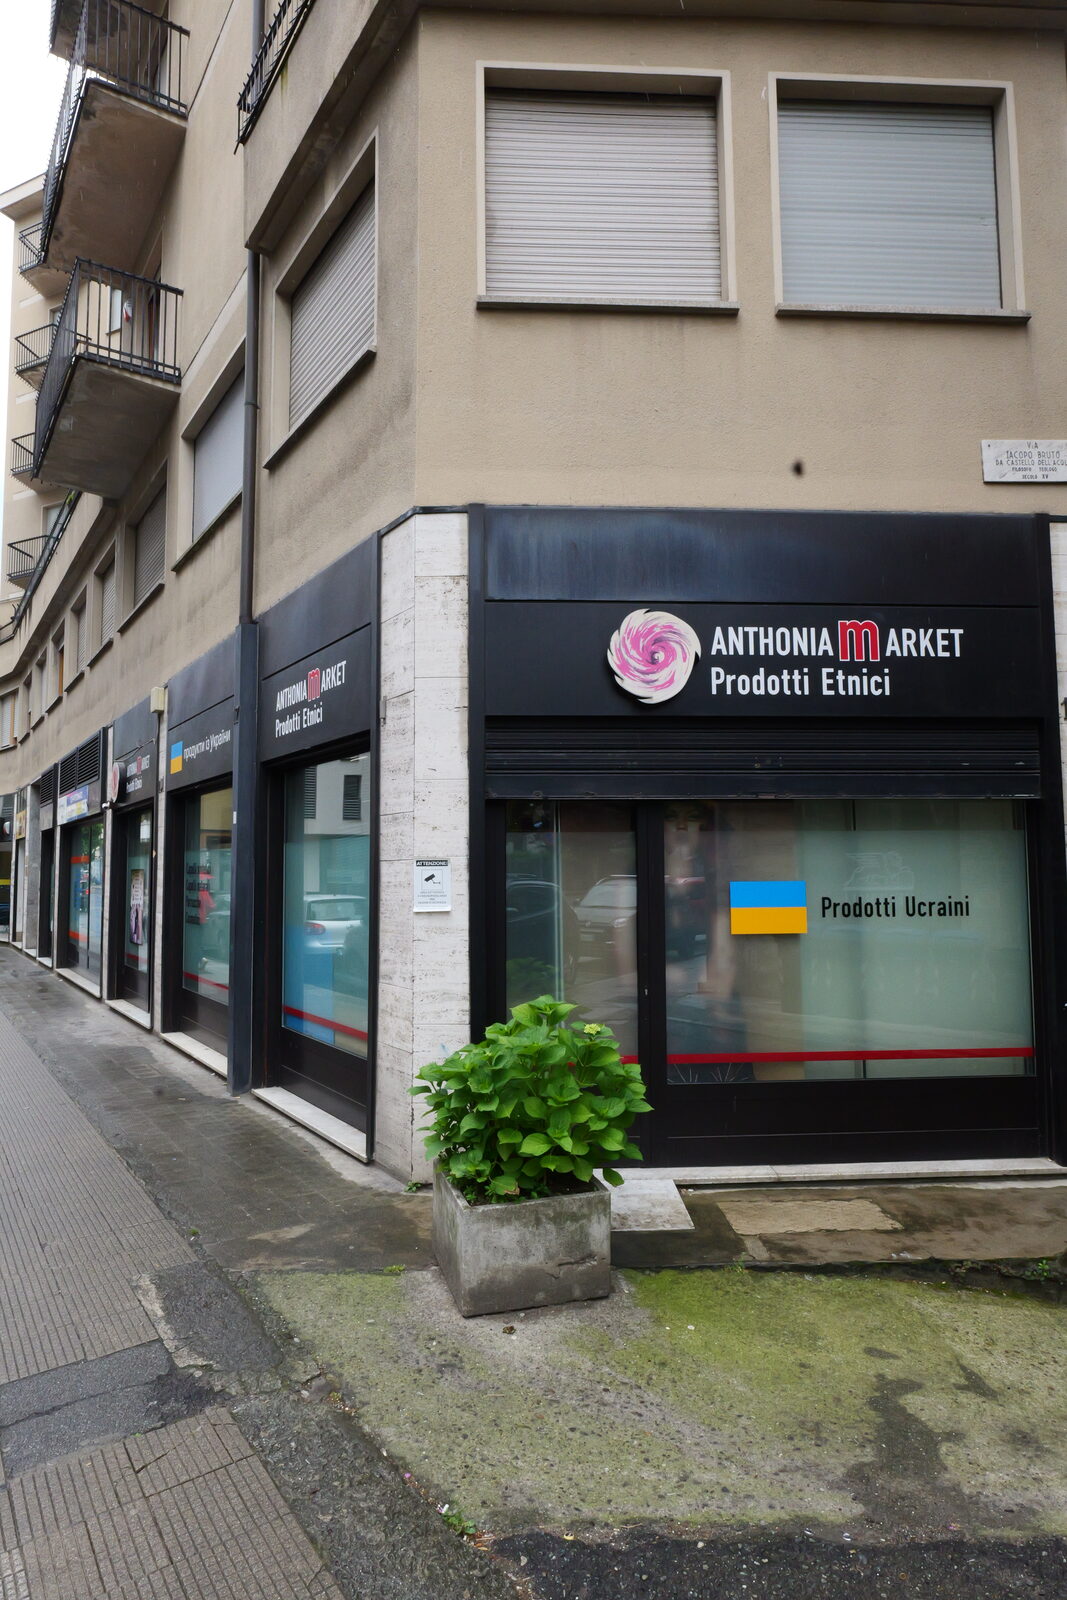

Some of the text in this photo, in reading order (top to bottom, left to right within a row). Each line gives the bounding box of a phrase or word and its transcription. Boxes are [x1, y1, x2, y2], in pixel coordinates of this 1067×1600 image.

[1006, 450, 1060, 459] IACOPO BRUTO
[1027, 441, 1039, 449] VIA
[711, 626, 834, 656] ANTHONIA
[275, 679, 308, 712] ANTHONIA
[711, 666, 891, 696] Prodotti Etnici
[275, 701, 323, 738] Prodotti Etnici
[821, 895, 970, 918] Prodotti Ucraini
